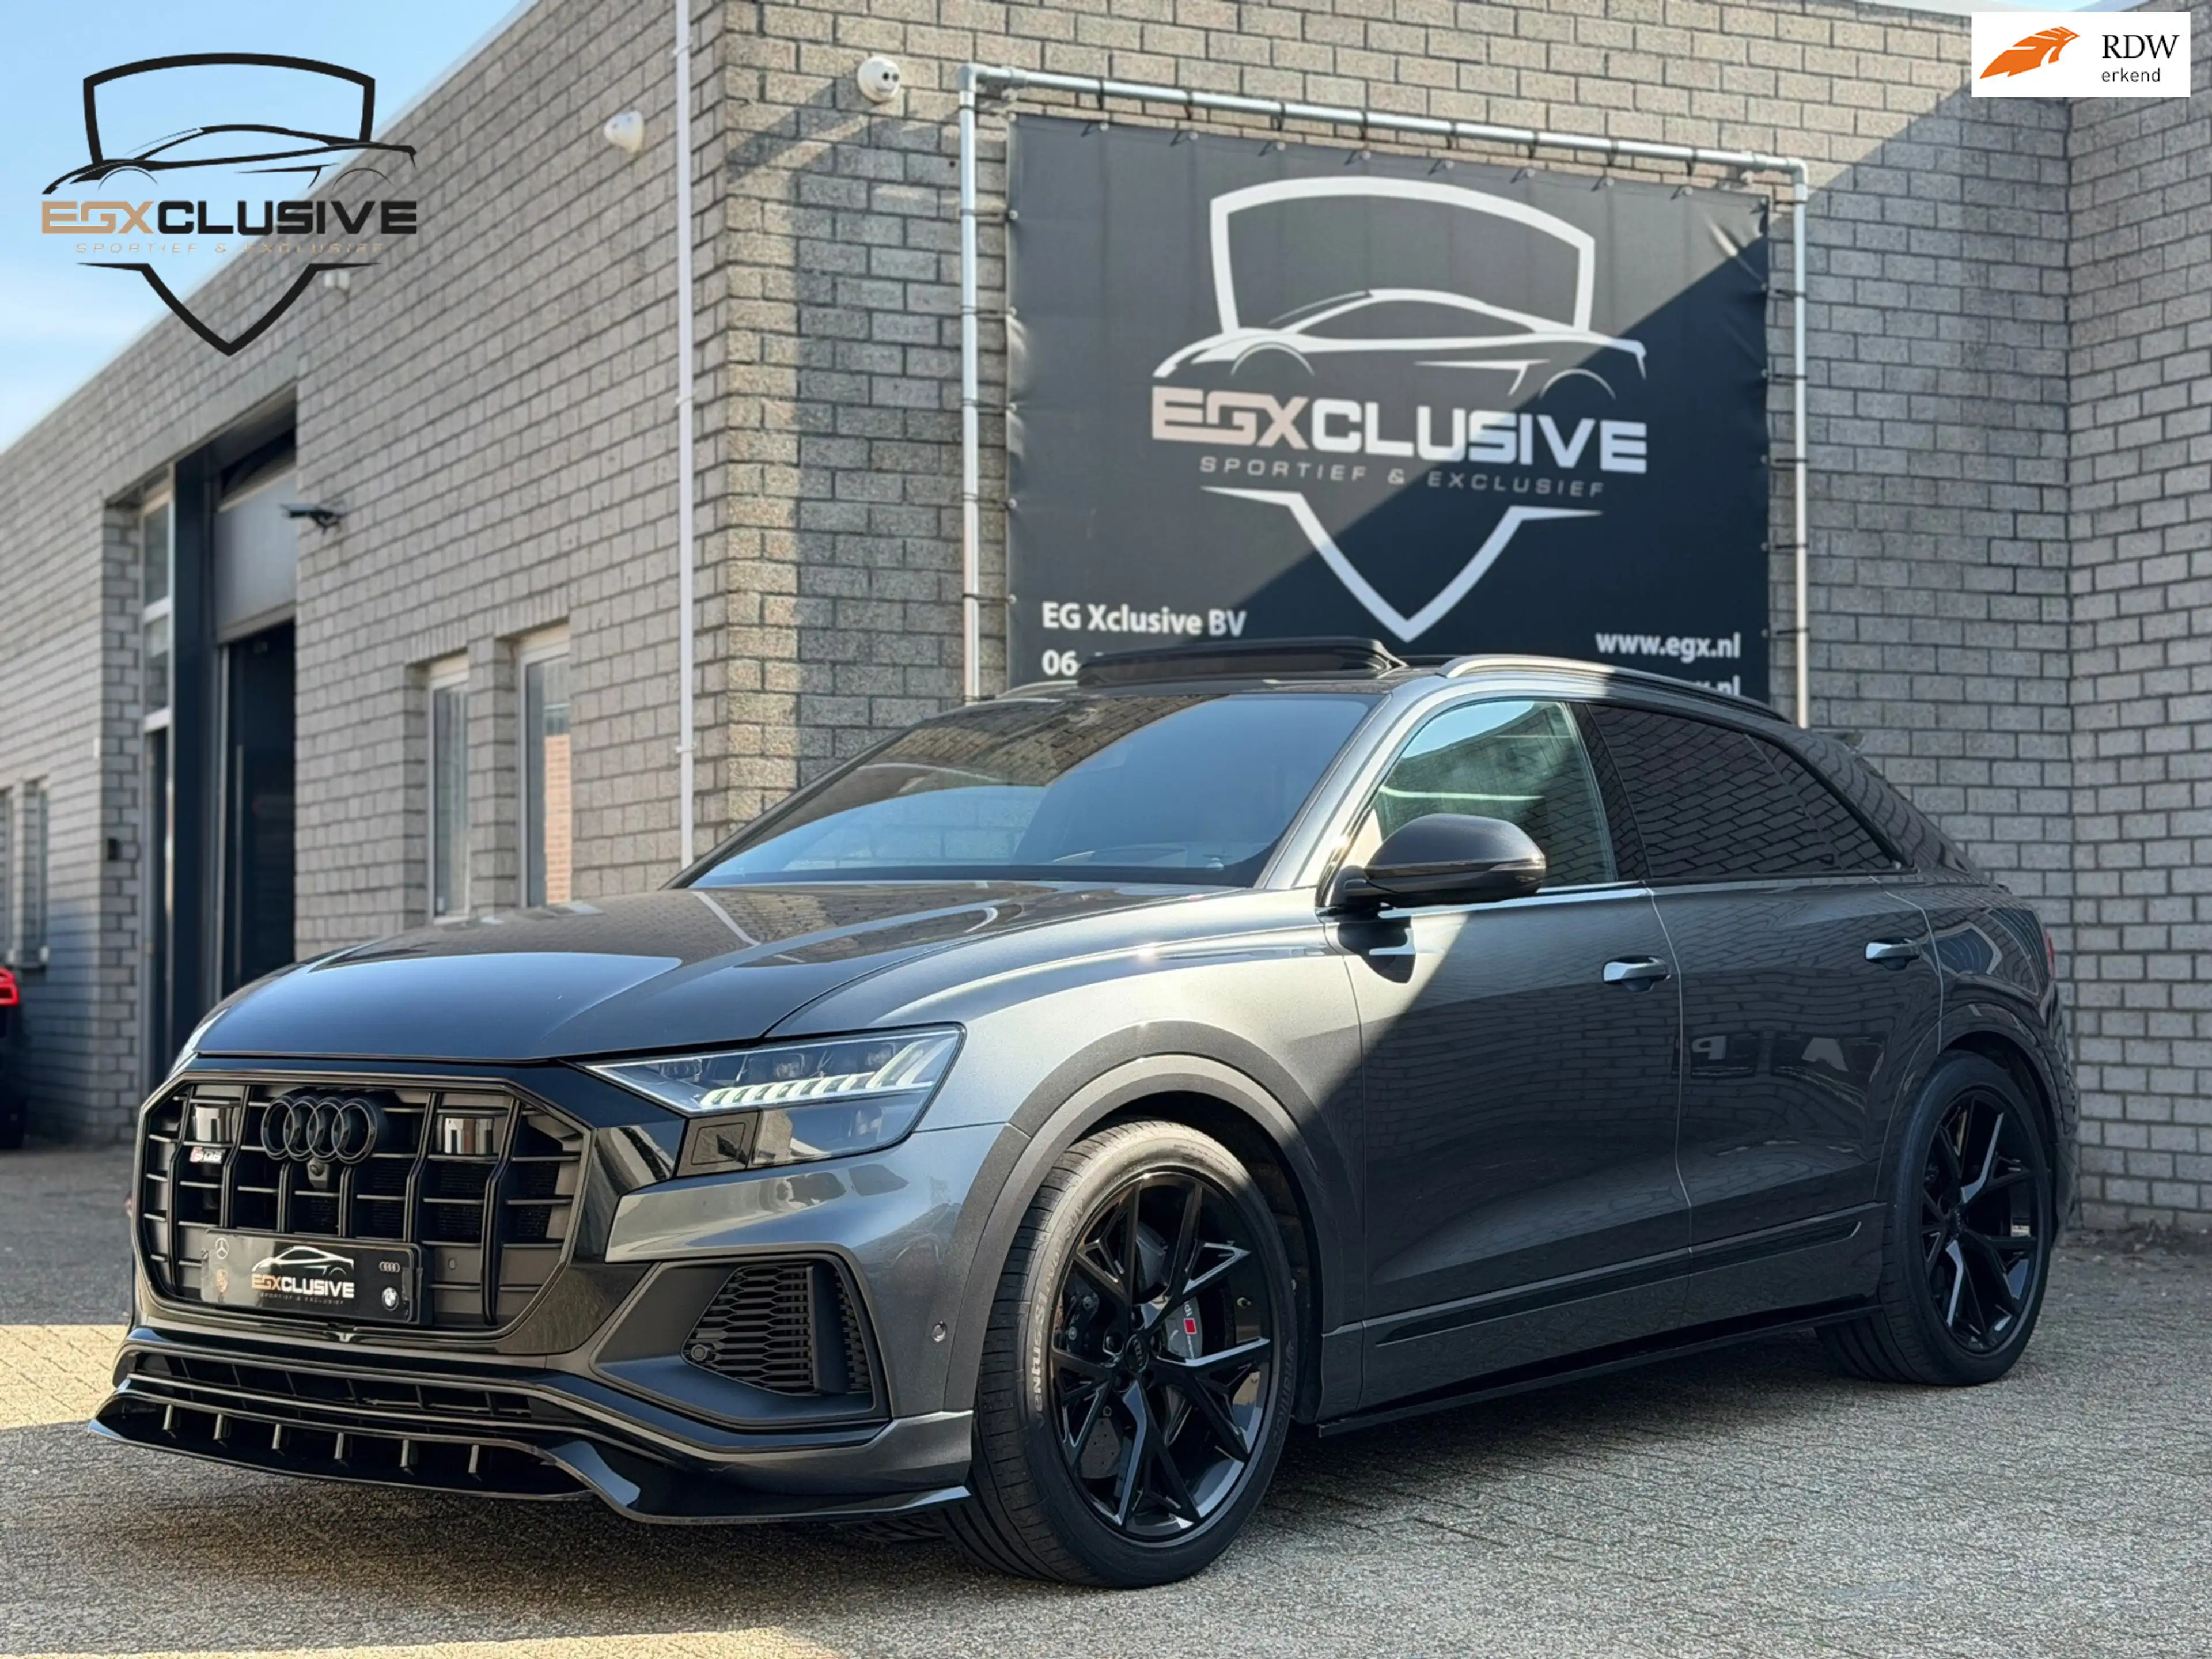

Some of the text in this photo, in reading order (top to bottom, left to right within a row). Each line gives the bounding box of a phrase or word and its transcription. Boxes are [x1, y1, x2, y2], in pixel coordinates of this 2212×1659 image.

[1152, 385, 1647, 474] EGXCLUSIVE
[1200, 456, 1604, 498] SPORTIEF & EXCLUSIEF
[1041, 601, 1247, 637] EG Xclusive BV
[1041, 649, 1082, 676] 06
[1595, 632, 1741, 664] www.egx.nl
[251, 1273, 355, 1299] EGXCLUSIVE
